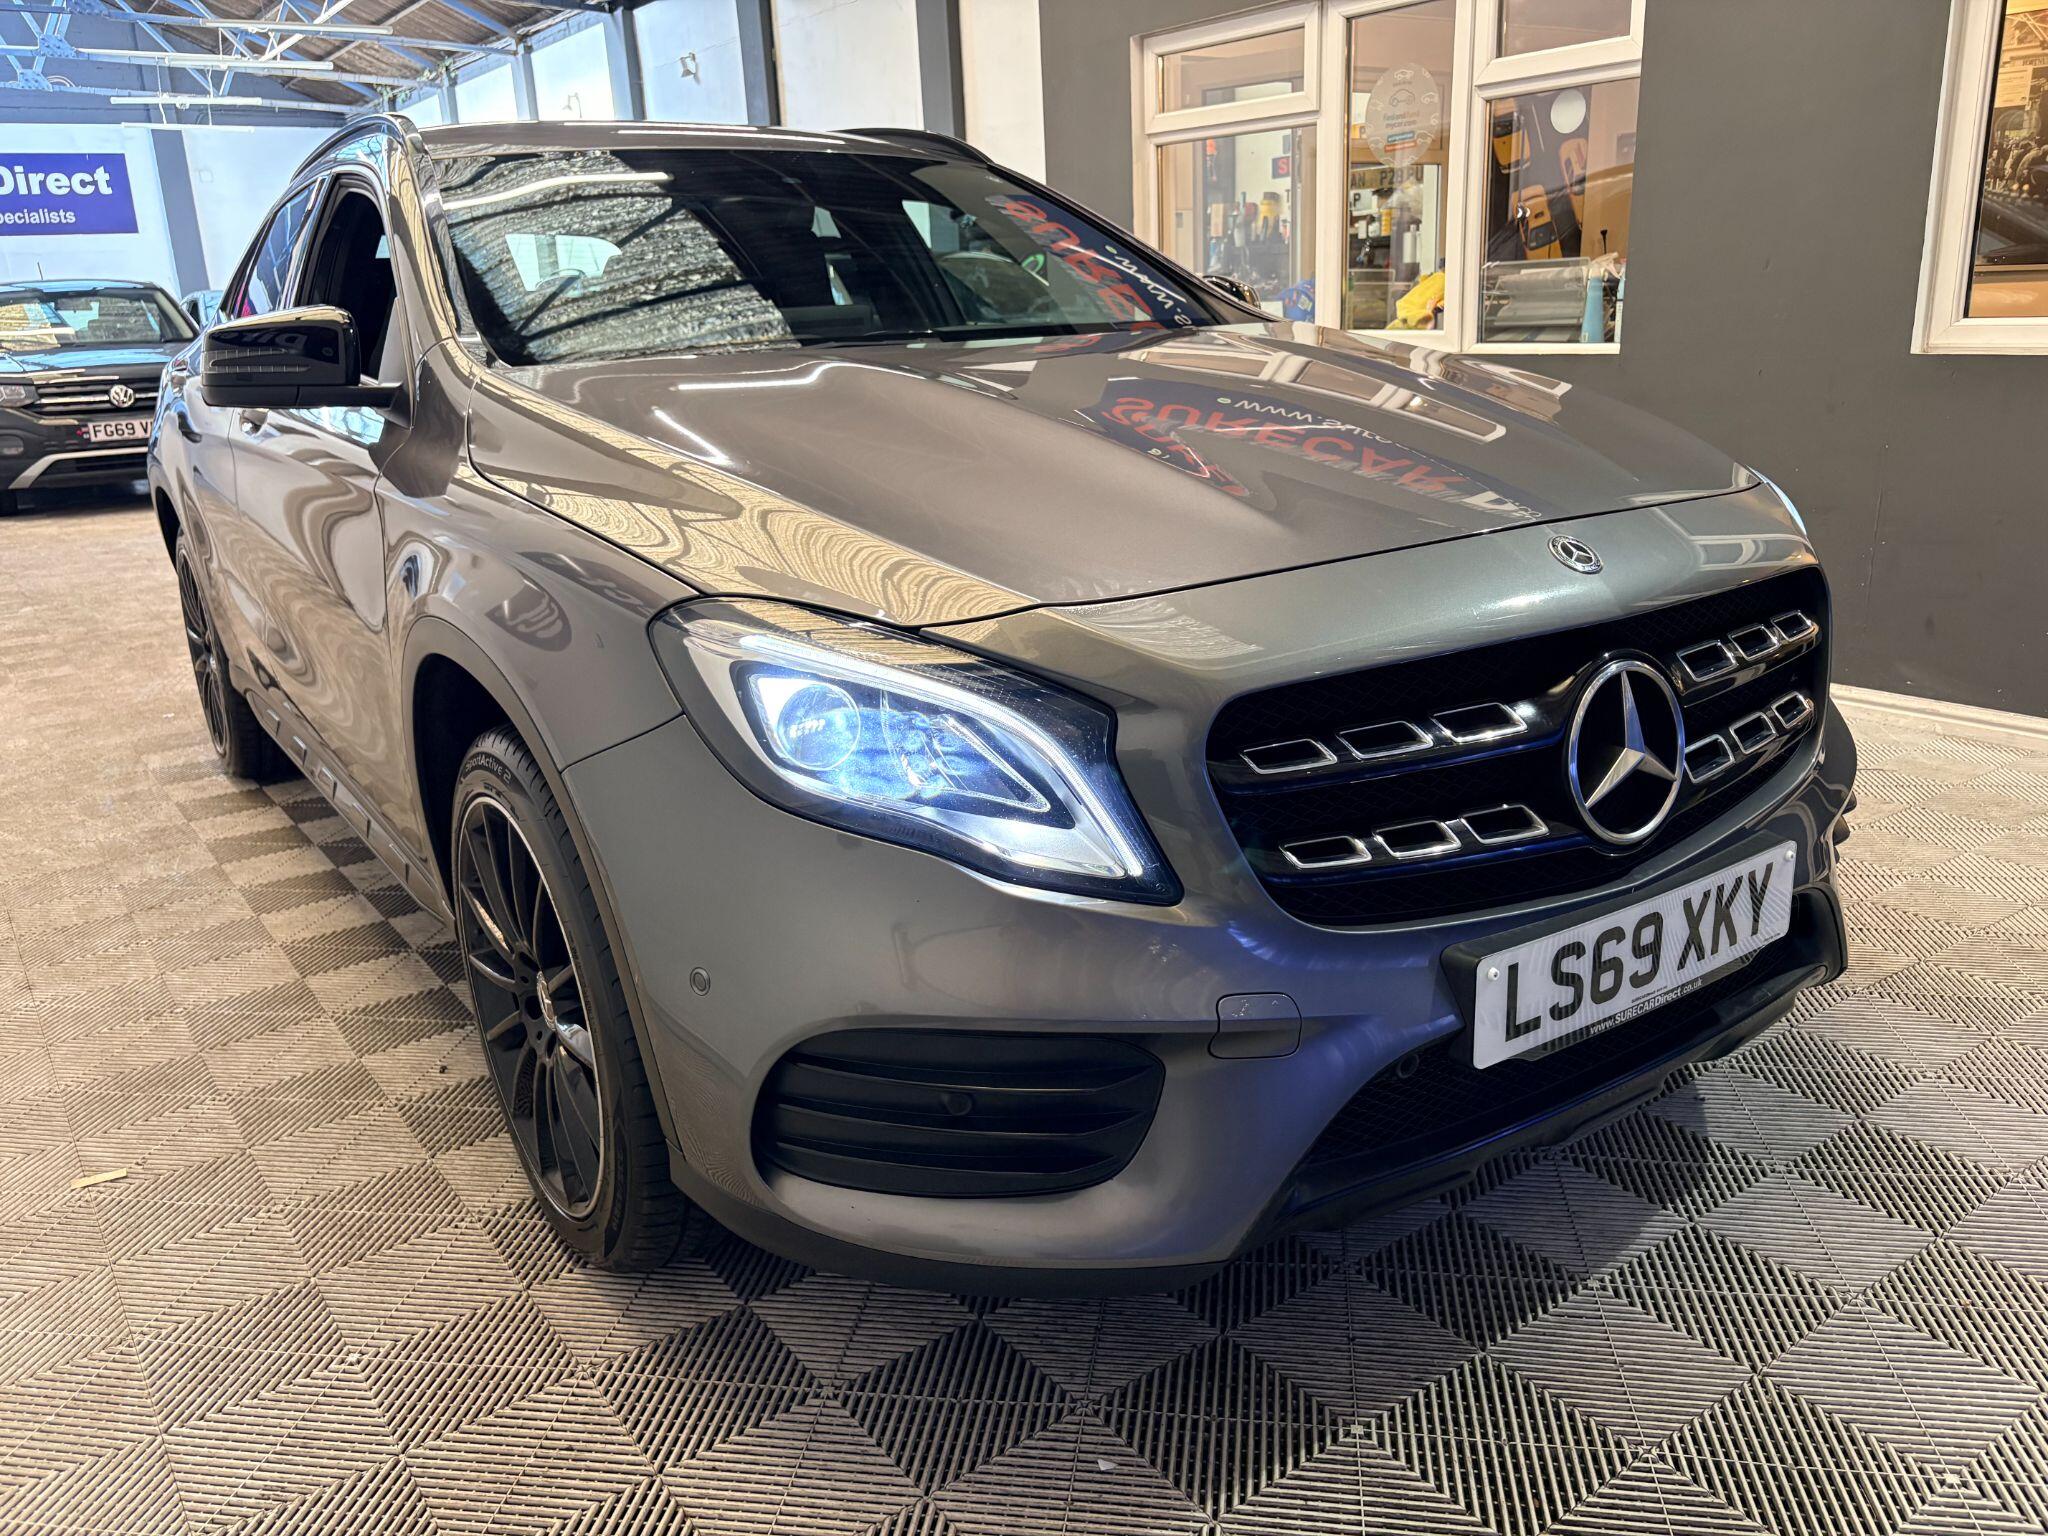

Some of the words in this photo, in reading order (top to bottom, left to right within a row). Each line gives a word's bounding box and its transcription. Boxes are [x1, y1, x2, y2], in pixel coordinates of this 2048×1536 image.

[0, 208, 77, 225] ecialists
[92, 422, 136, 438] FG69
[1505, 911, 1664, 1043] LS69
[1677, 861, 1774, 972] XKY
[1589, 978, 1703, 1035] www.SURECARDirect.co.uk
